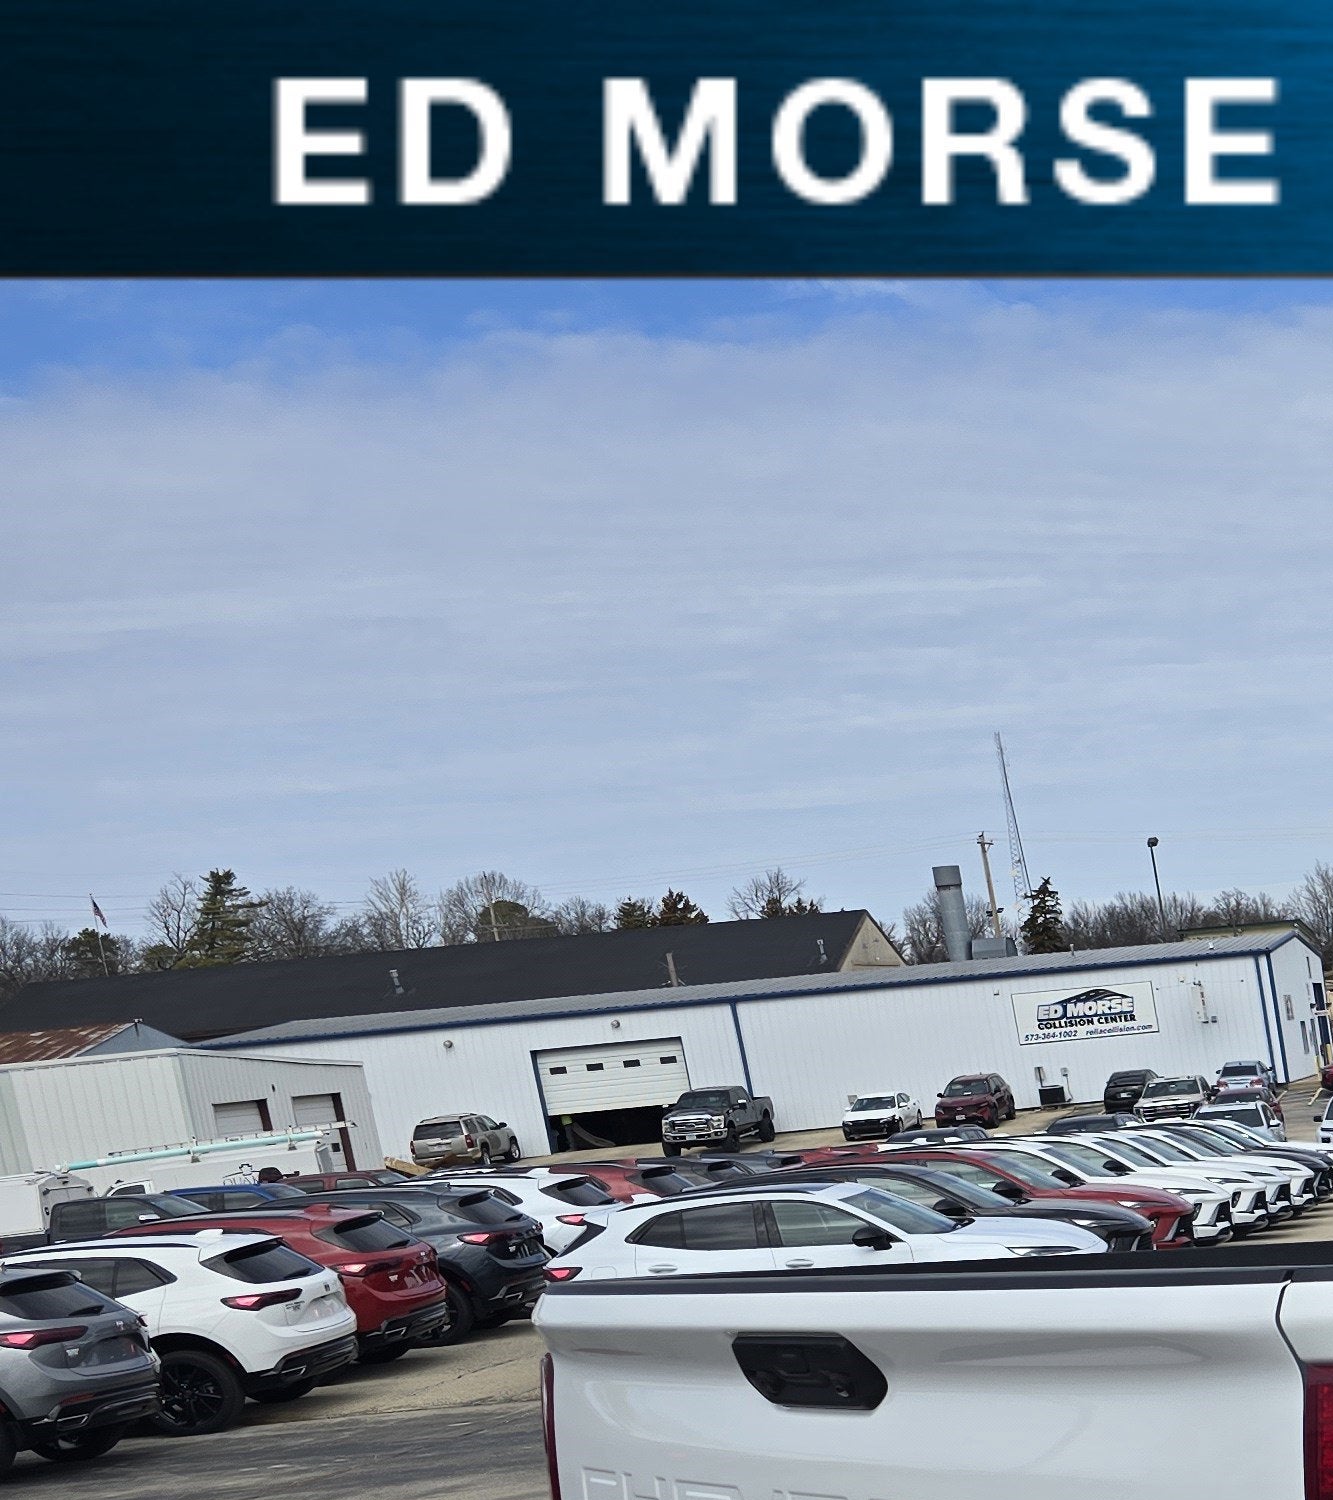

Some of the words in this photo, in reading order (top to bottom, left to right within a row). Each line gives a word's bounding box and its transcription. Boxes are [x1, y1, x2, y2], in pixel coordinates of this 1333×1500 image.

[1038, 1004, 1063, 1020] ED
[1066, 997, 1134, 1018] MORSE
[1037, 1017, 1094, 1030] COLLISION
[1097, 1014, 1137, 1025] CENTER
